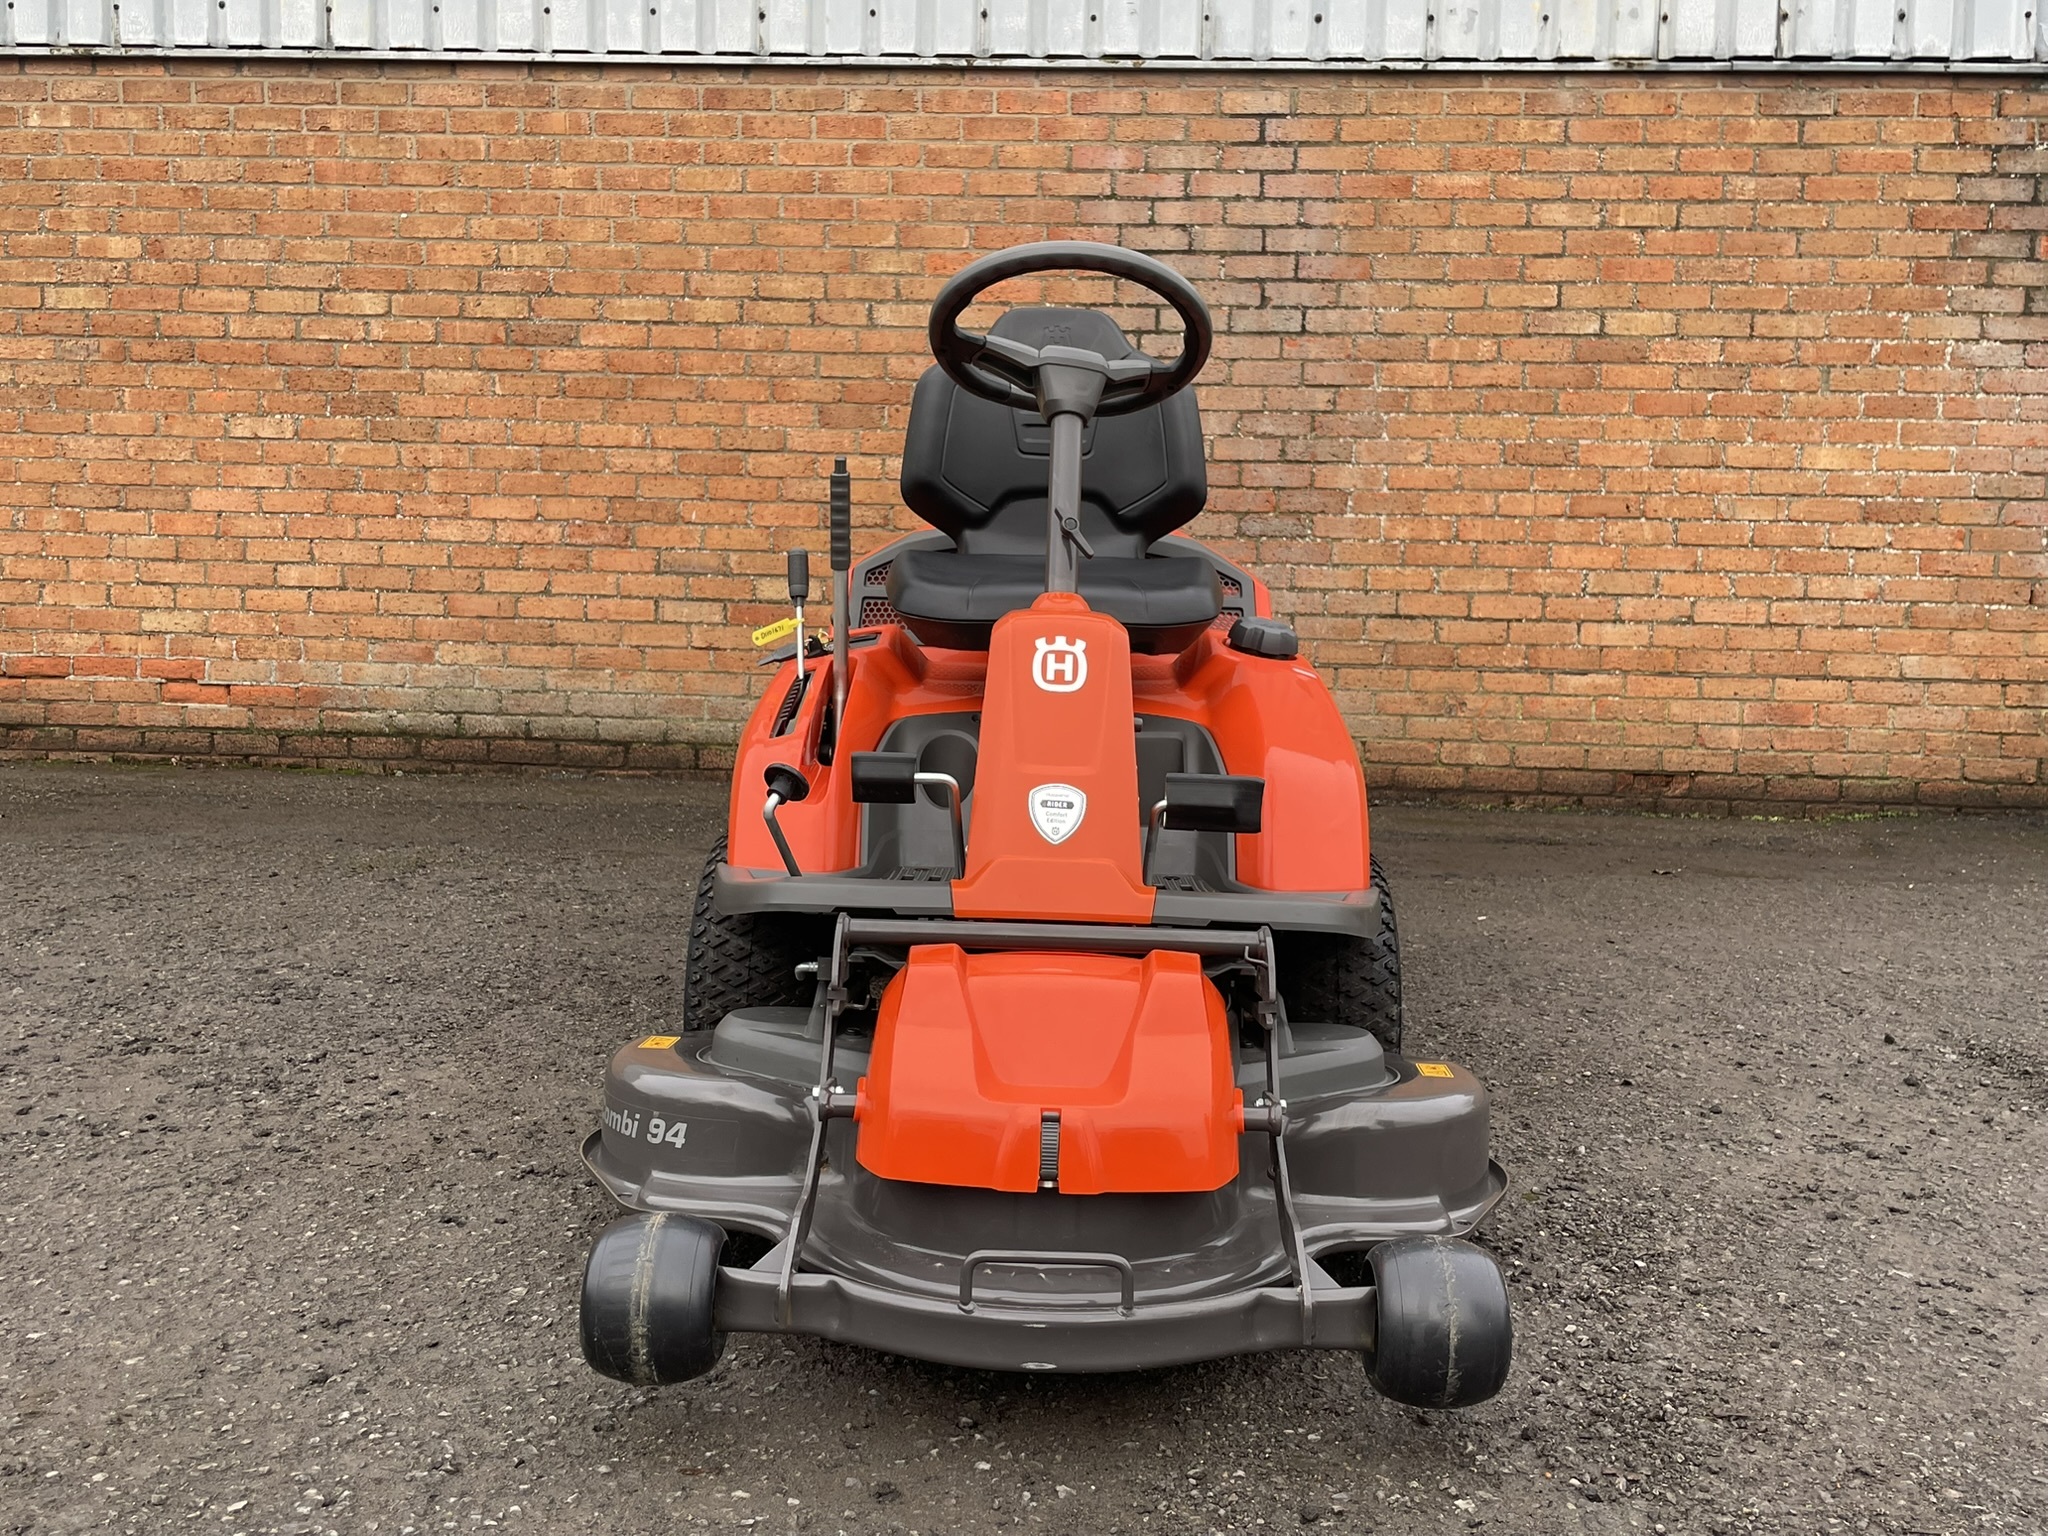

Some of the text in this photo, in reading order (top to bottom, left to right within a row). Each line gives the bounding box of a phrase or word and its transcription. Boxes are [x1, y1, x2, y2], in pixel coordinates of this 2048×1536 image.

[1046, 800, 1068, 809] RIDER
[603, 1106, 688, 1149] ombi 94
